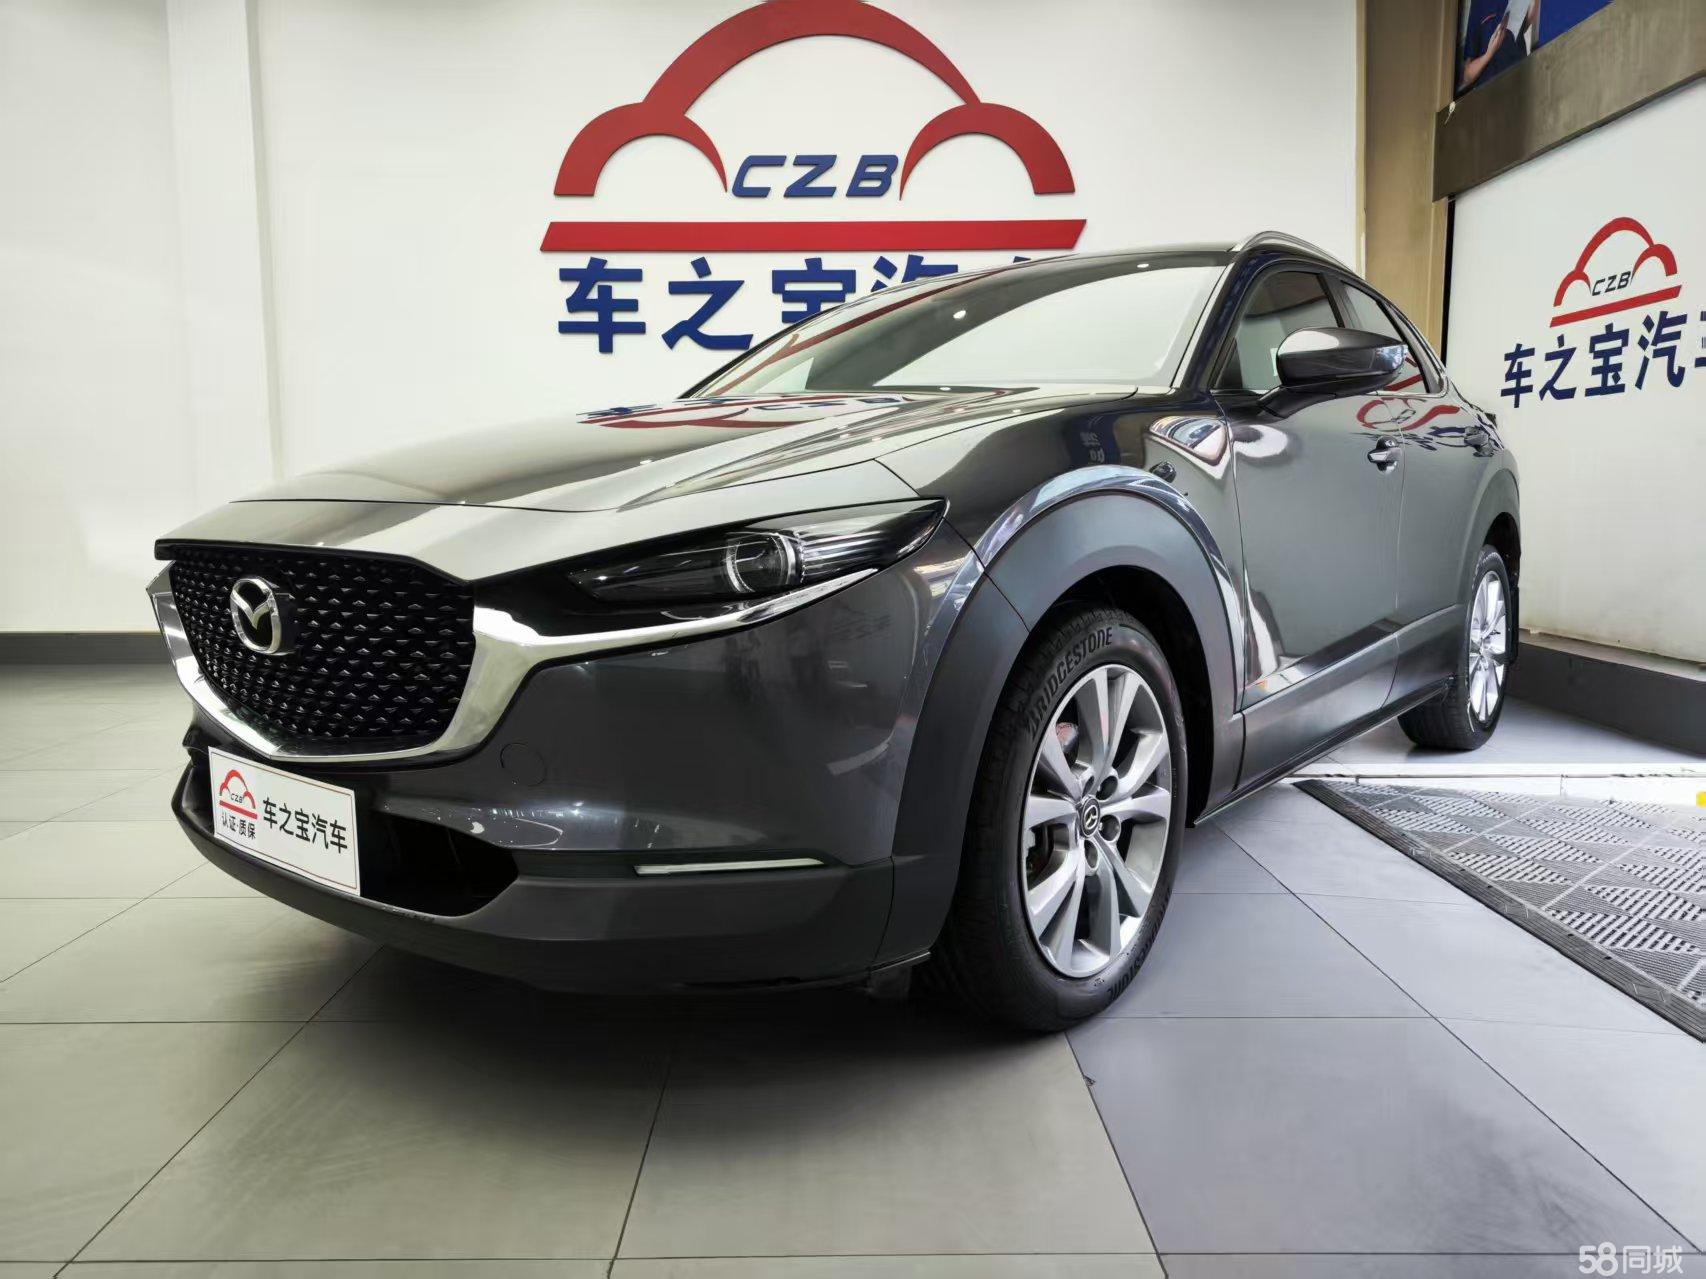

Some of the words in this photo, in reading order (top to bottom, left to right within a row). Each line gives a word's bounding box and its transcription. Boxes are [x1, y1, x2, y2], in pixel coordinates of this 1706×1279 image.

[732, 154, 899, 198] CZB
[558, 254, 1031, 354] 车之宝
[1591, 271, 1632, 296] CZB
[1500, 310, 1706, 408] 车之宝汽
[1026, 627, 1113, 740] BRIDGESTONE
[230, 793, 244, 803] CZB
[262, 797, 348, 854] 车之宝汽车
